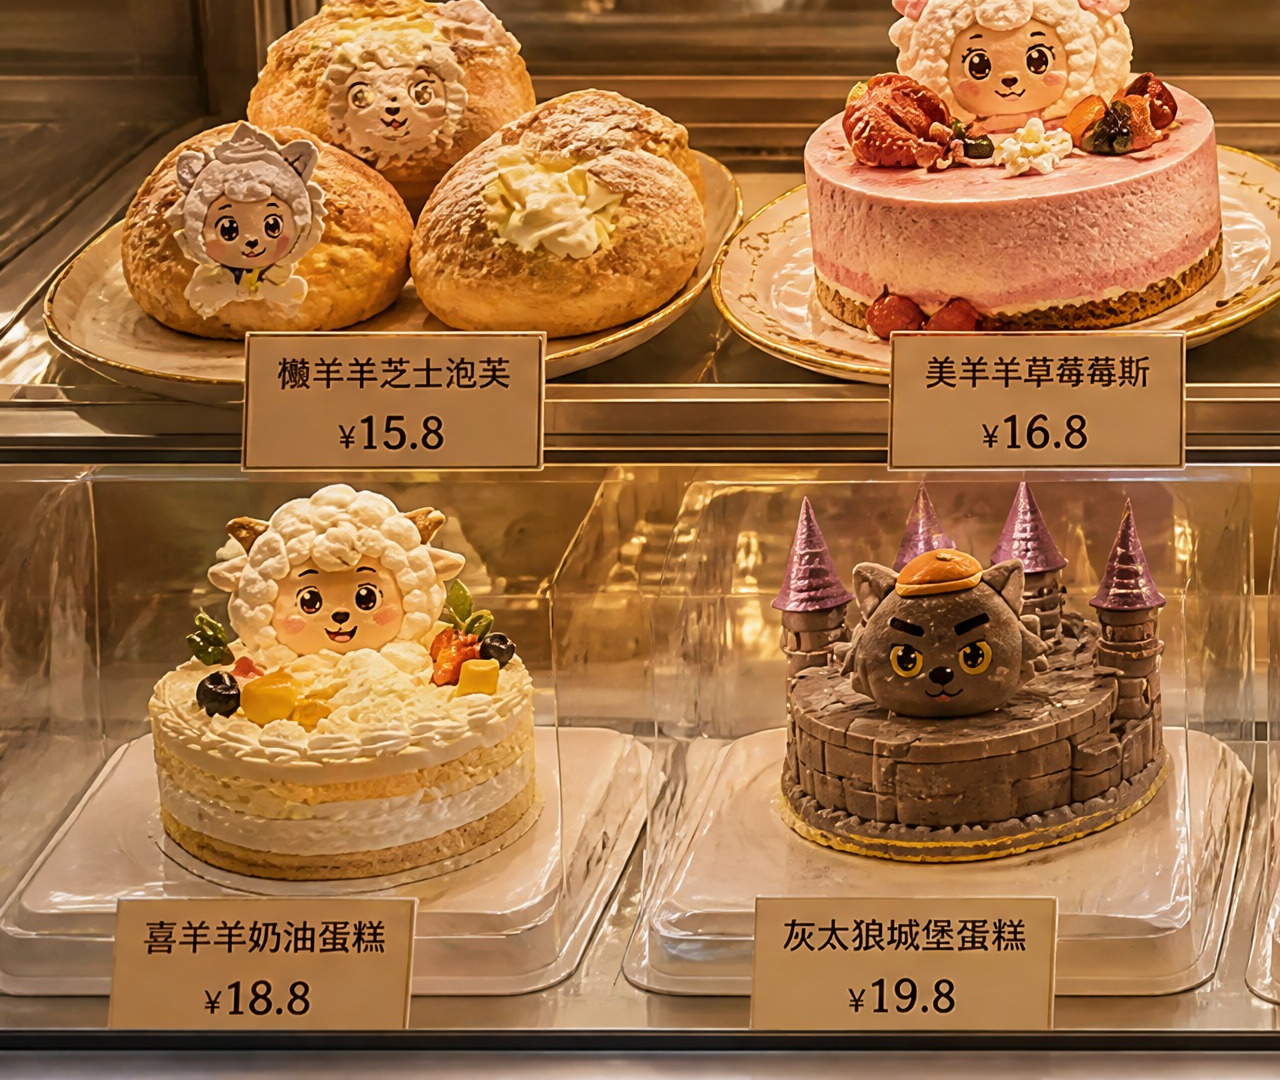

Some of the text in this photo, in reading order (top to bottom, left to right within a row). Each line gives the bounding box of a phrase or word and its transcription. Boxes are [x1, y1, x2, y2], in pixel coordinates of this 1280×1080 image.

[338, 415, 444, 451] ¥15.8
[981, 413, 1088, 450] ¥16.8
[143, 920, 386, 955] 喜羊羊奶油蛋糕
[783, 918, 1026, 952] 灰太狼城堡蛋糕
[204, 979, 310, 1016] ¥18.8
[848, 977, 956, 1014] ¥19.8
